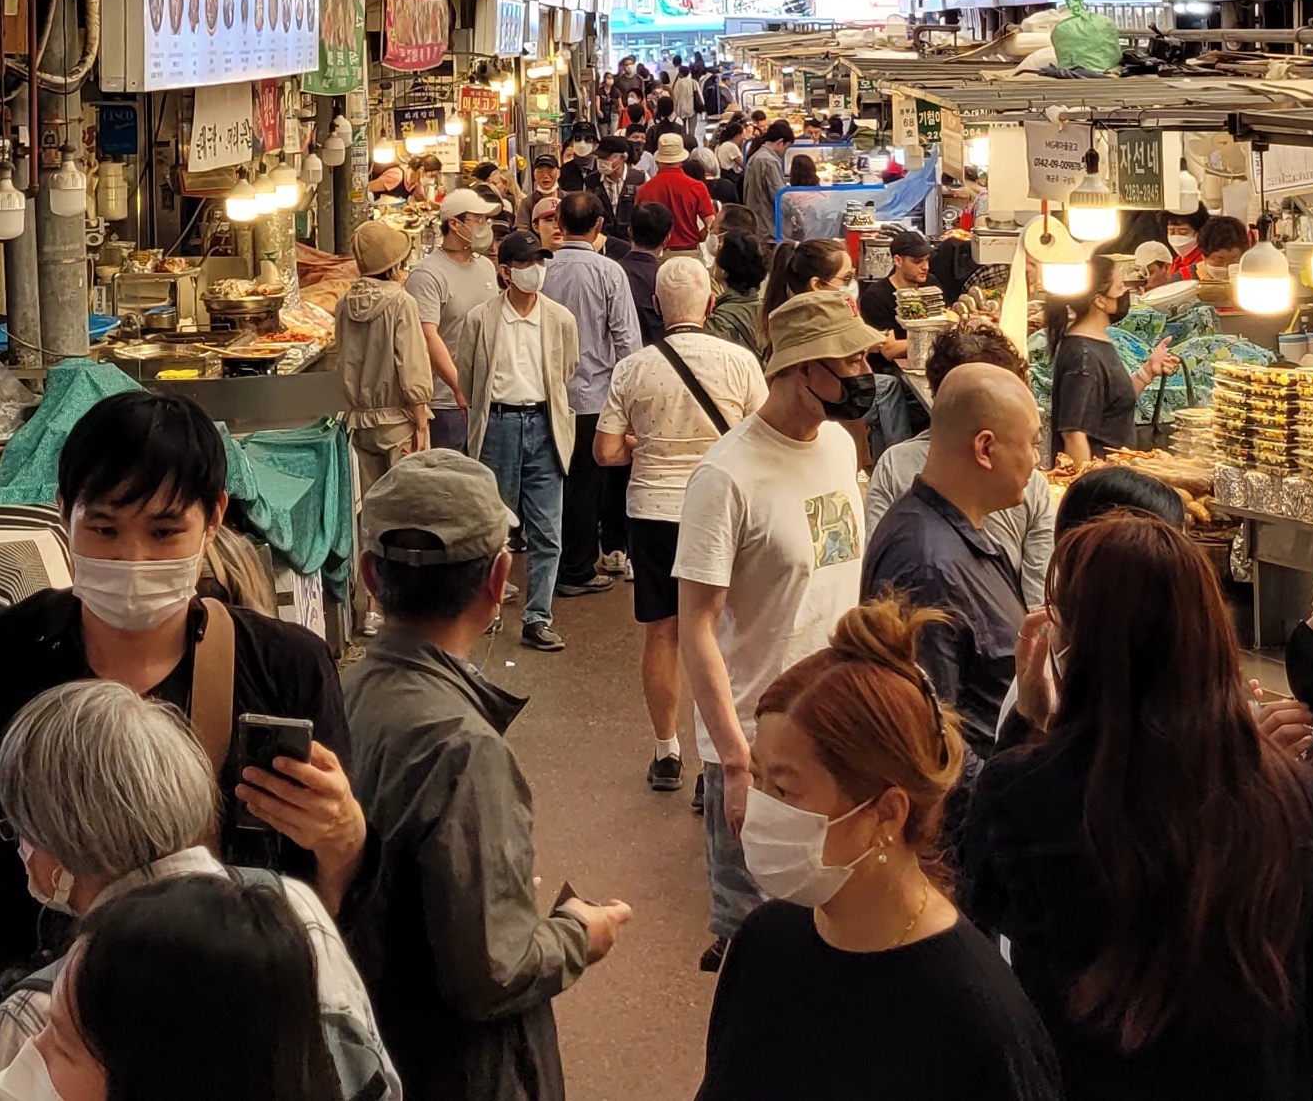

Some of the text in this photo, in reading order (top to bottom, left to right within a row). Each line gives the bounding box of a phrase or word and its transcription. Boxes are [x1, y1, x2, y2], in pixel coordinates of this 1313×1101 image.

[461, 97, 500, 112] 머릿고기
[903, 118, 915, 128] 68
[1119, 140, 1160, 176] 자선네
